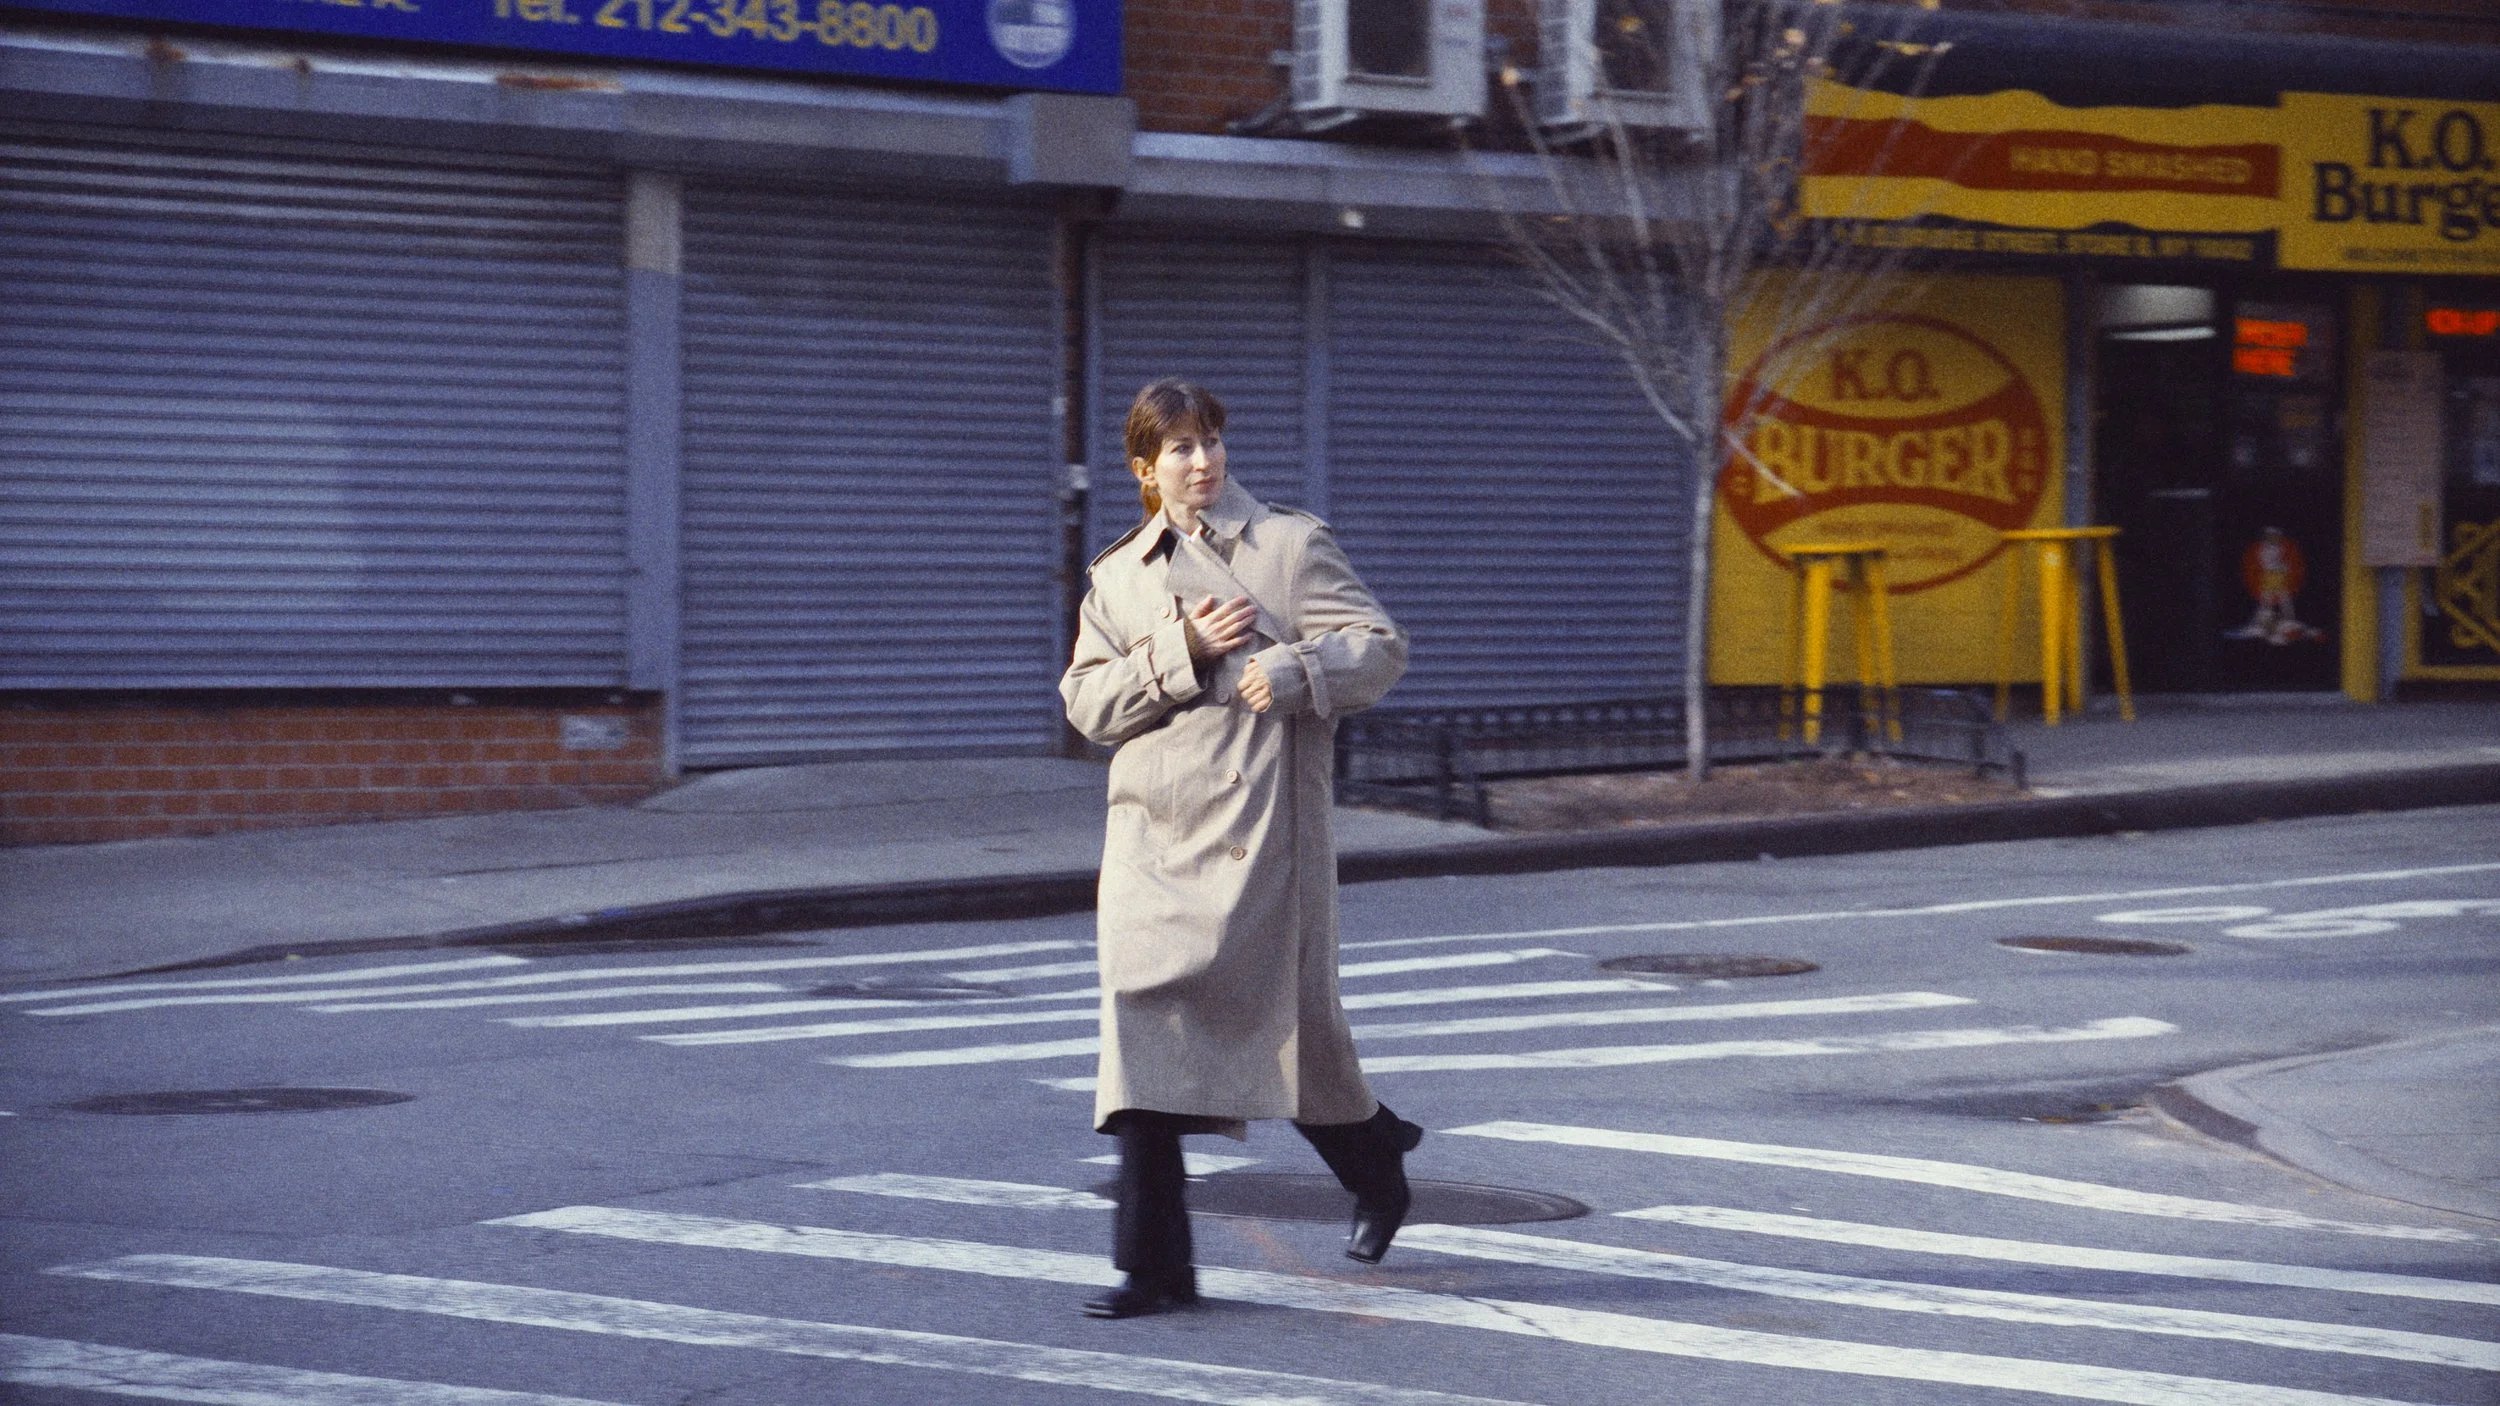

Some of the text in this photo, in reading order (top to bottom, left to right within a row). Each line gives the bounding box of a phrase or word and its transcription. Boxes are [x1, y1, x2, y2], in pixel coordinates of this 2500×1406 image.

[595, 0, 939, 53] 212-343-8800
[2364, 108, 2496, 172] K.O.
[1752, 416, 2016, 504] BURGER
